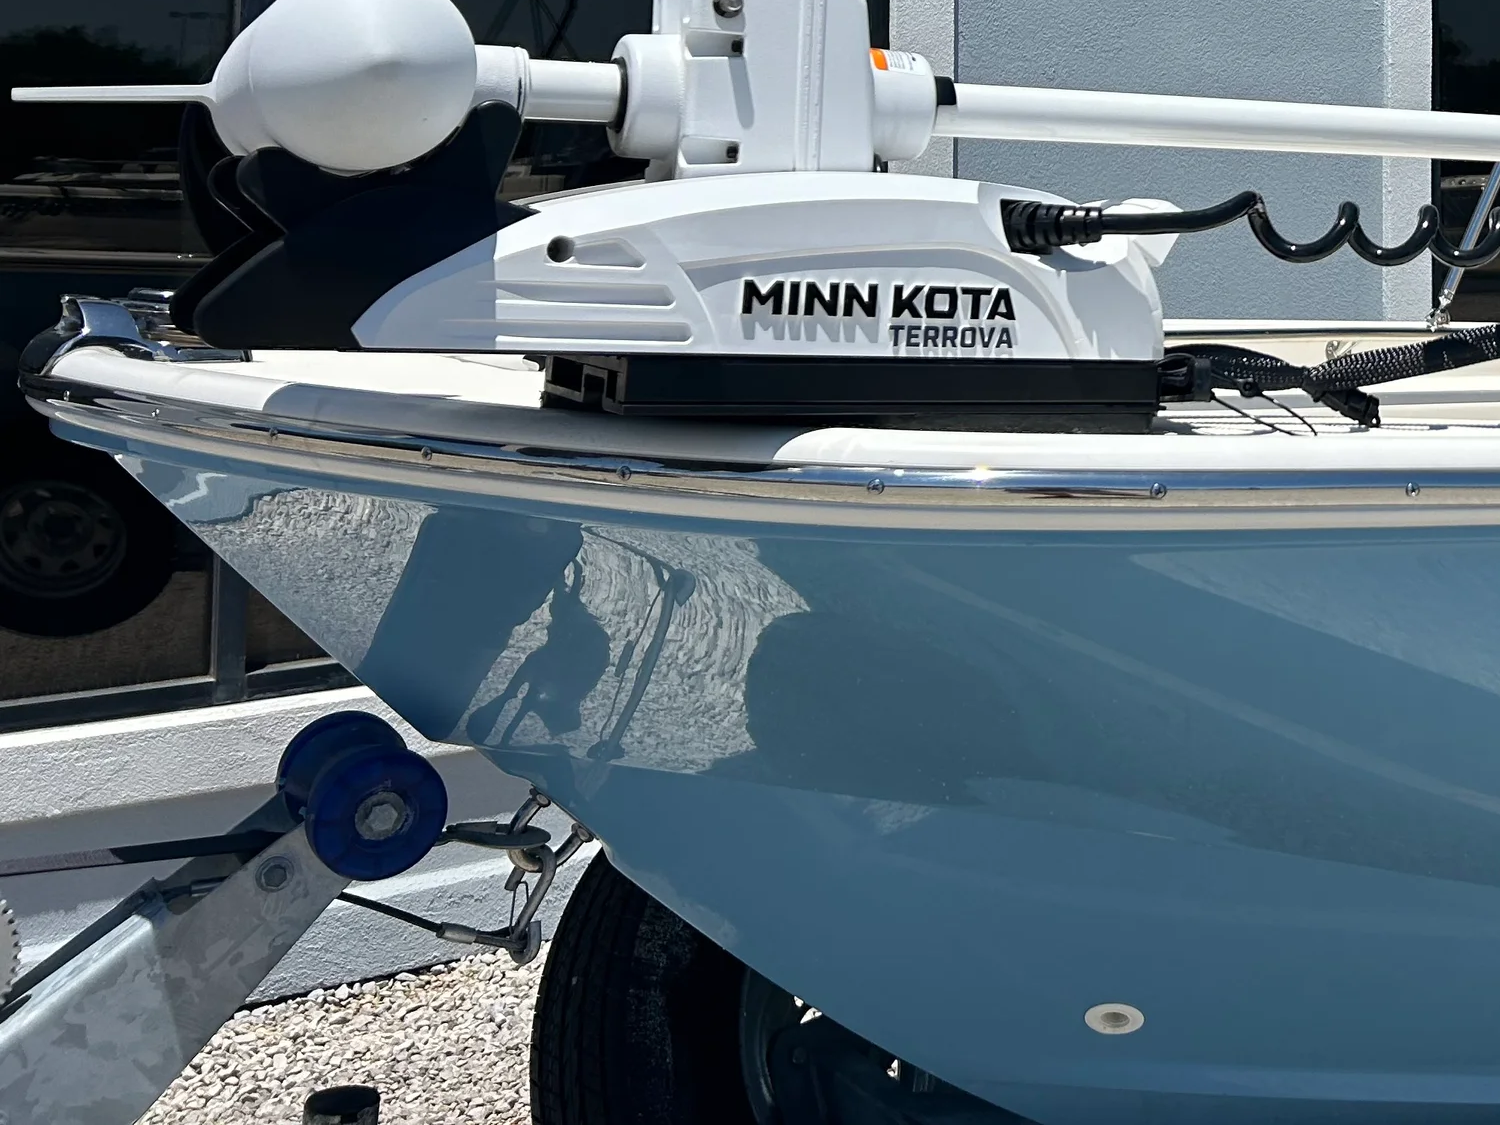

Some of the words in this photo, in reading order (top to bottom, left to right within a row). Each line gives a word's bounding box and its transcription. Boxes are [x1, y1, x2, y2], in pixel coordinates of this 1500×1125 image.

[741, 279, 879, 317] MINN
[891, 284, 1016, 321] KOTA
[889, 325, 1013, 349] TERROVA
